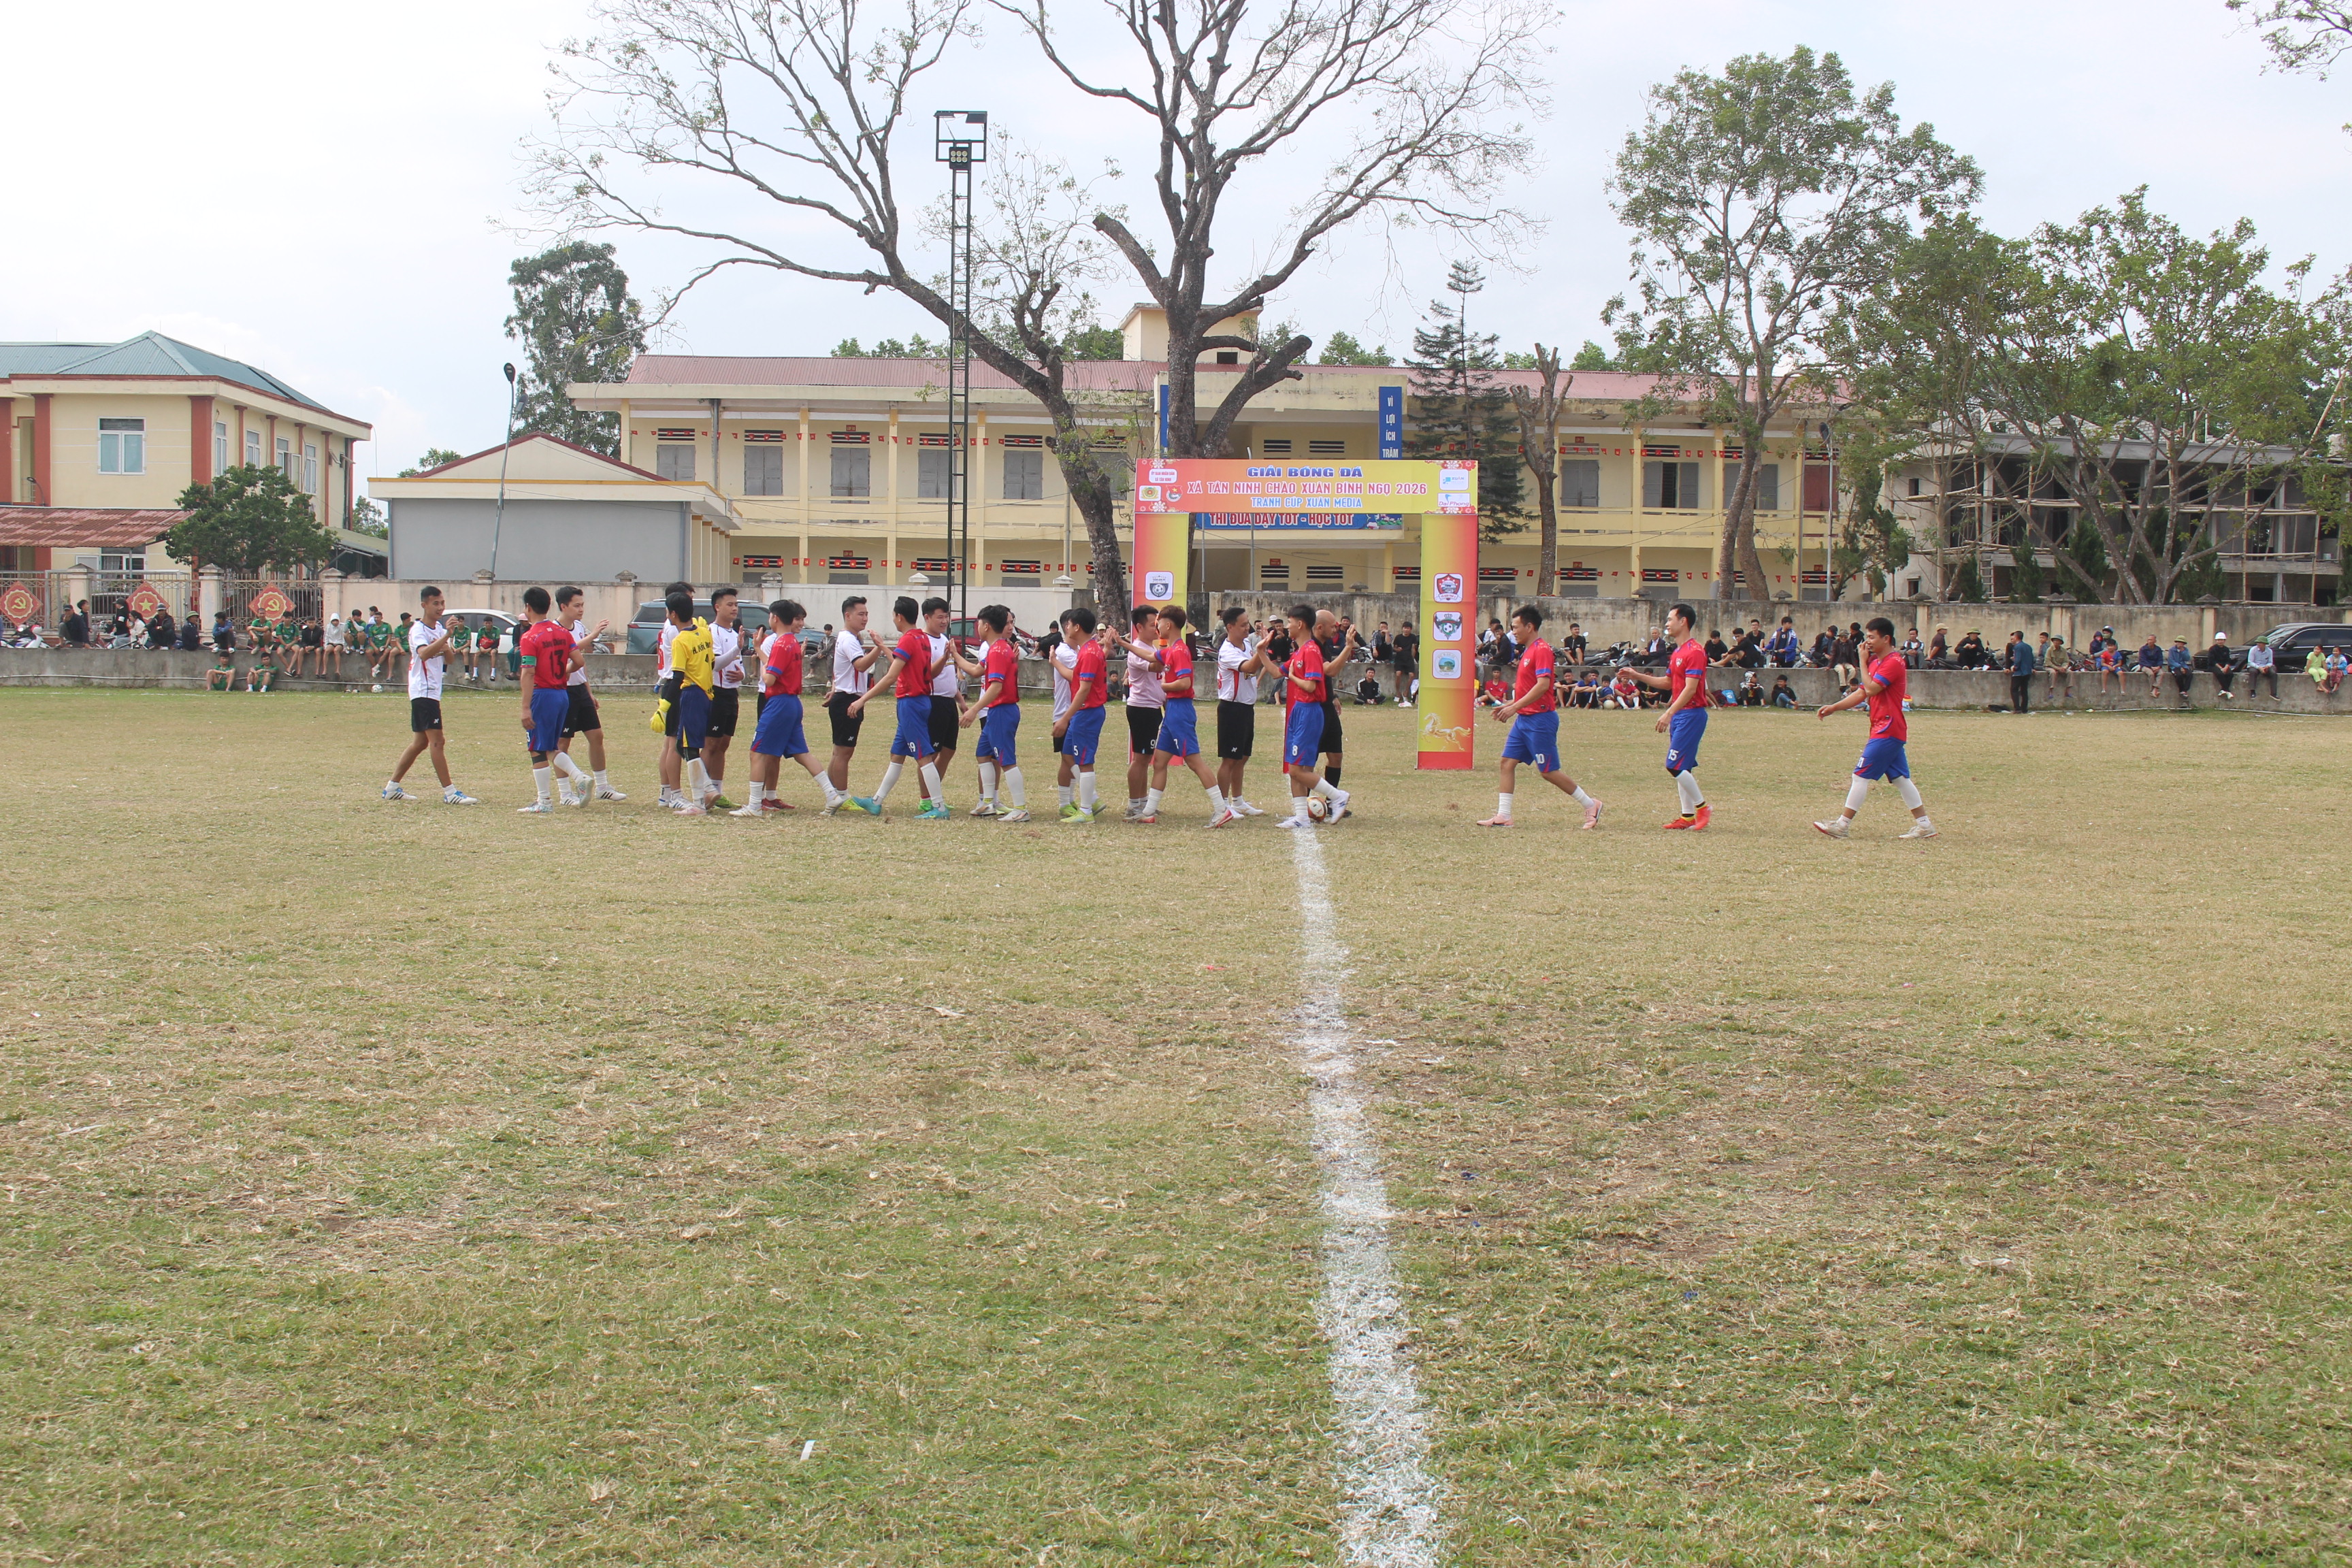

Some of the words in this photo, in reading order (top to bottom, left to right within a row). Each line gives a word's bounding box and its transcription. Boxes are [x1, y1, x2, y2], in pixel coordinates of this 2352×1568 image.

[1387, 395, 1394, 407] VÌ
[1386, 413, 1395, 426] LỢI
[1386, 429, 1396, 441] ÍCH
[1382, 447, 1399, 458] TRĂM
[1247, 466, 1282, 478] GIẢI
[1288, 466, 1334, 478] BÓNG
[1339, 466, 1362, 478] ĐÁ
[1187, 480, 1203, 493] XÃ
[1207, 480, 1230, 493] TÂN
[1233, 482, 1261, 494] NINH
[1265, 481, 1296, 494] CHÀO
[1301, 481, 1331, 494] XUÂN
[1367, 482, 1391, 496] NGỌ
[1396, 483, 1427, 495] 2026
[1251, 497, 1281, 508] TRANH
[1284, 495, 1303, 508] CÚP
[1306, 495, 1330, 508] XUÂN
[1333, 497, 1362, 508] MEDIA
[1209, 512, 1228, 525] THI
[1229, 512, 1252, 525] ĐUA
[1254, 512, 1276, 528] DẠY
[1308, 513, 1332, 528] HỌC
[549, 649, 565, 680] 13
[1073, 745, 1079, 756] 5
[1292, 745, 1298, 756] 8
[1667, 749, 1679, 761] 15
[1535, 753, 1545, 764] 10
